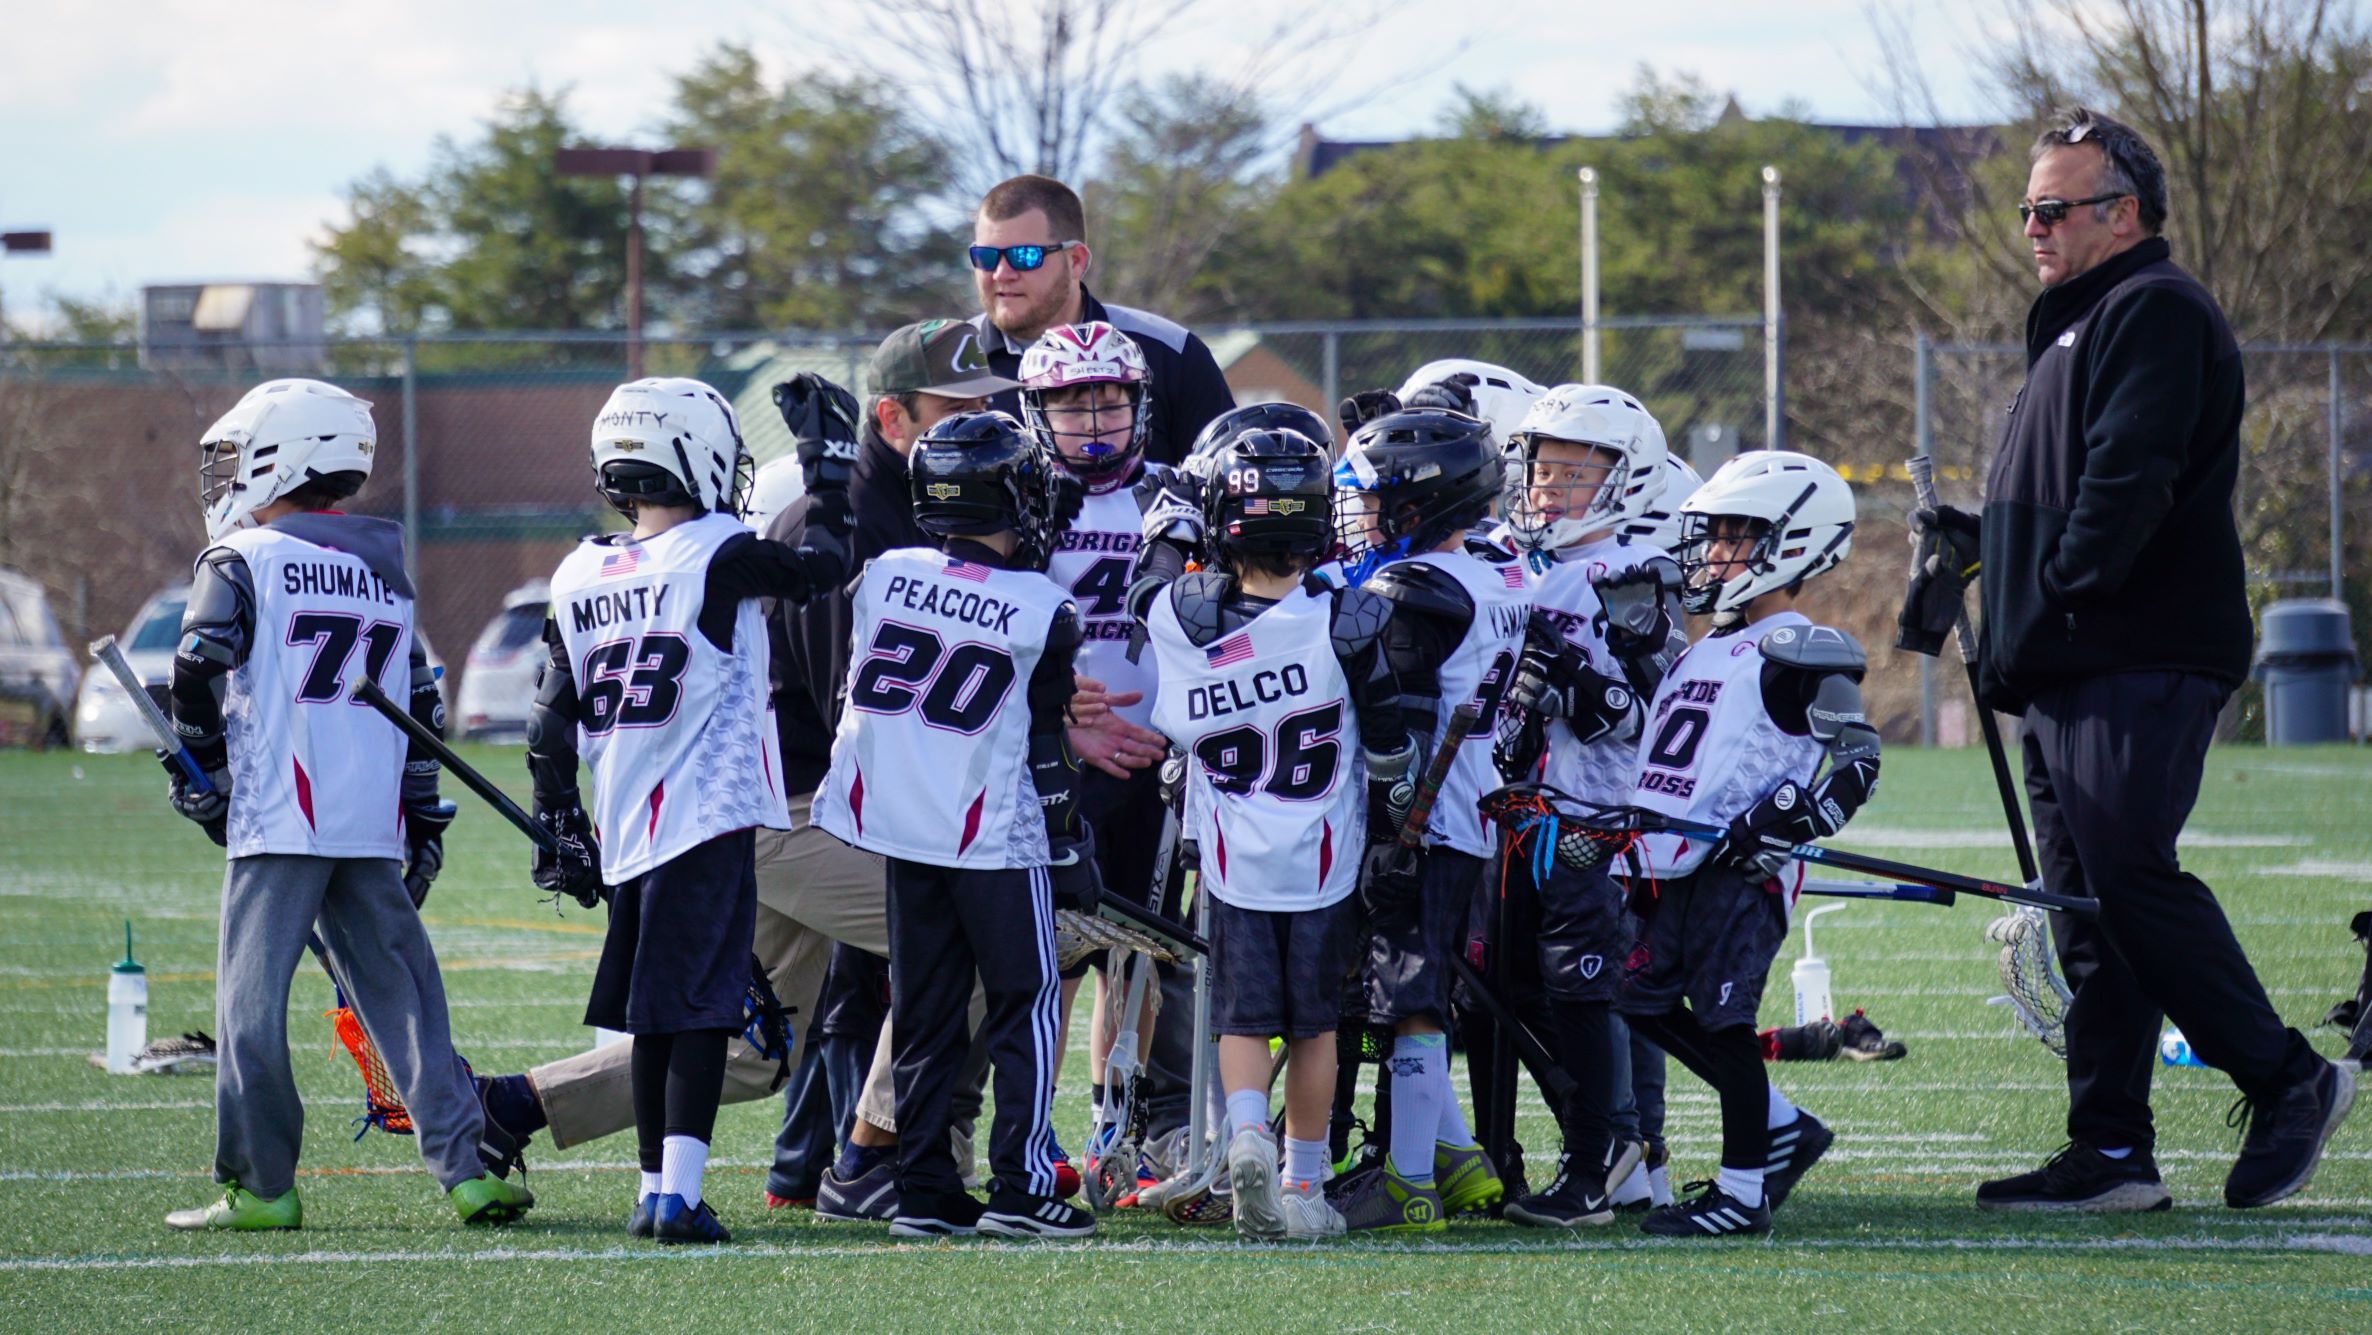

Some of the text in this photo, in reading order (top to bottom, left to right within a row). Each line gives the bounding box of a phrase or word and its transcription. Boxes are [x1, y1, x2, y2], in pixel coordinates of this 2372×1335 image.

[599, 410, 669, 431] MONTY
[1228, 467, 1260, 496] 99
[283, 562, 395, 606] SHUMATE
[571, 584, 670, 634] MONTY
[884, 576, 1020, 636] PEACOCK
[286, 610, 404, 706] 71
[580, 631, 693, 738] 63
[851, 618, 1017, 736] 20
[1188, 663, 1309, 722] DELCO
[1193, 697, 1345, 803] 96
